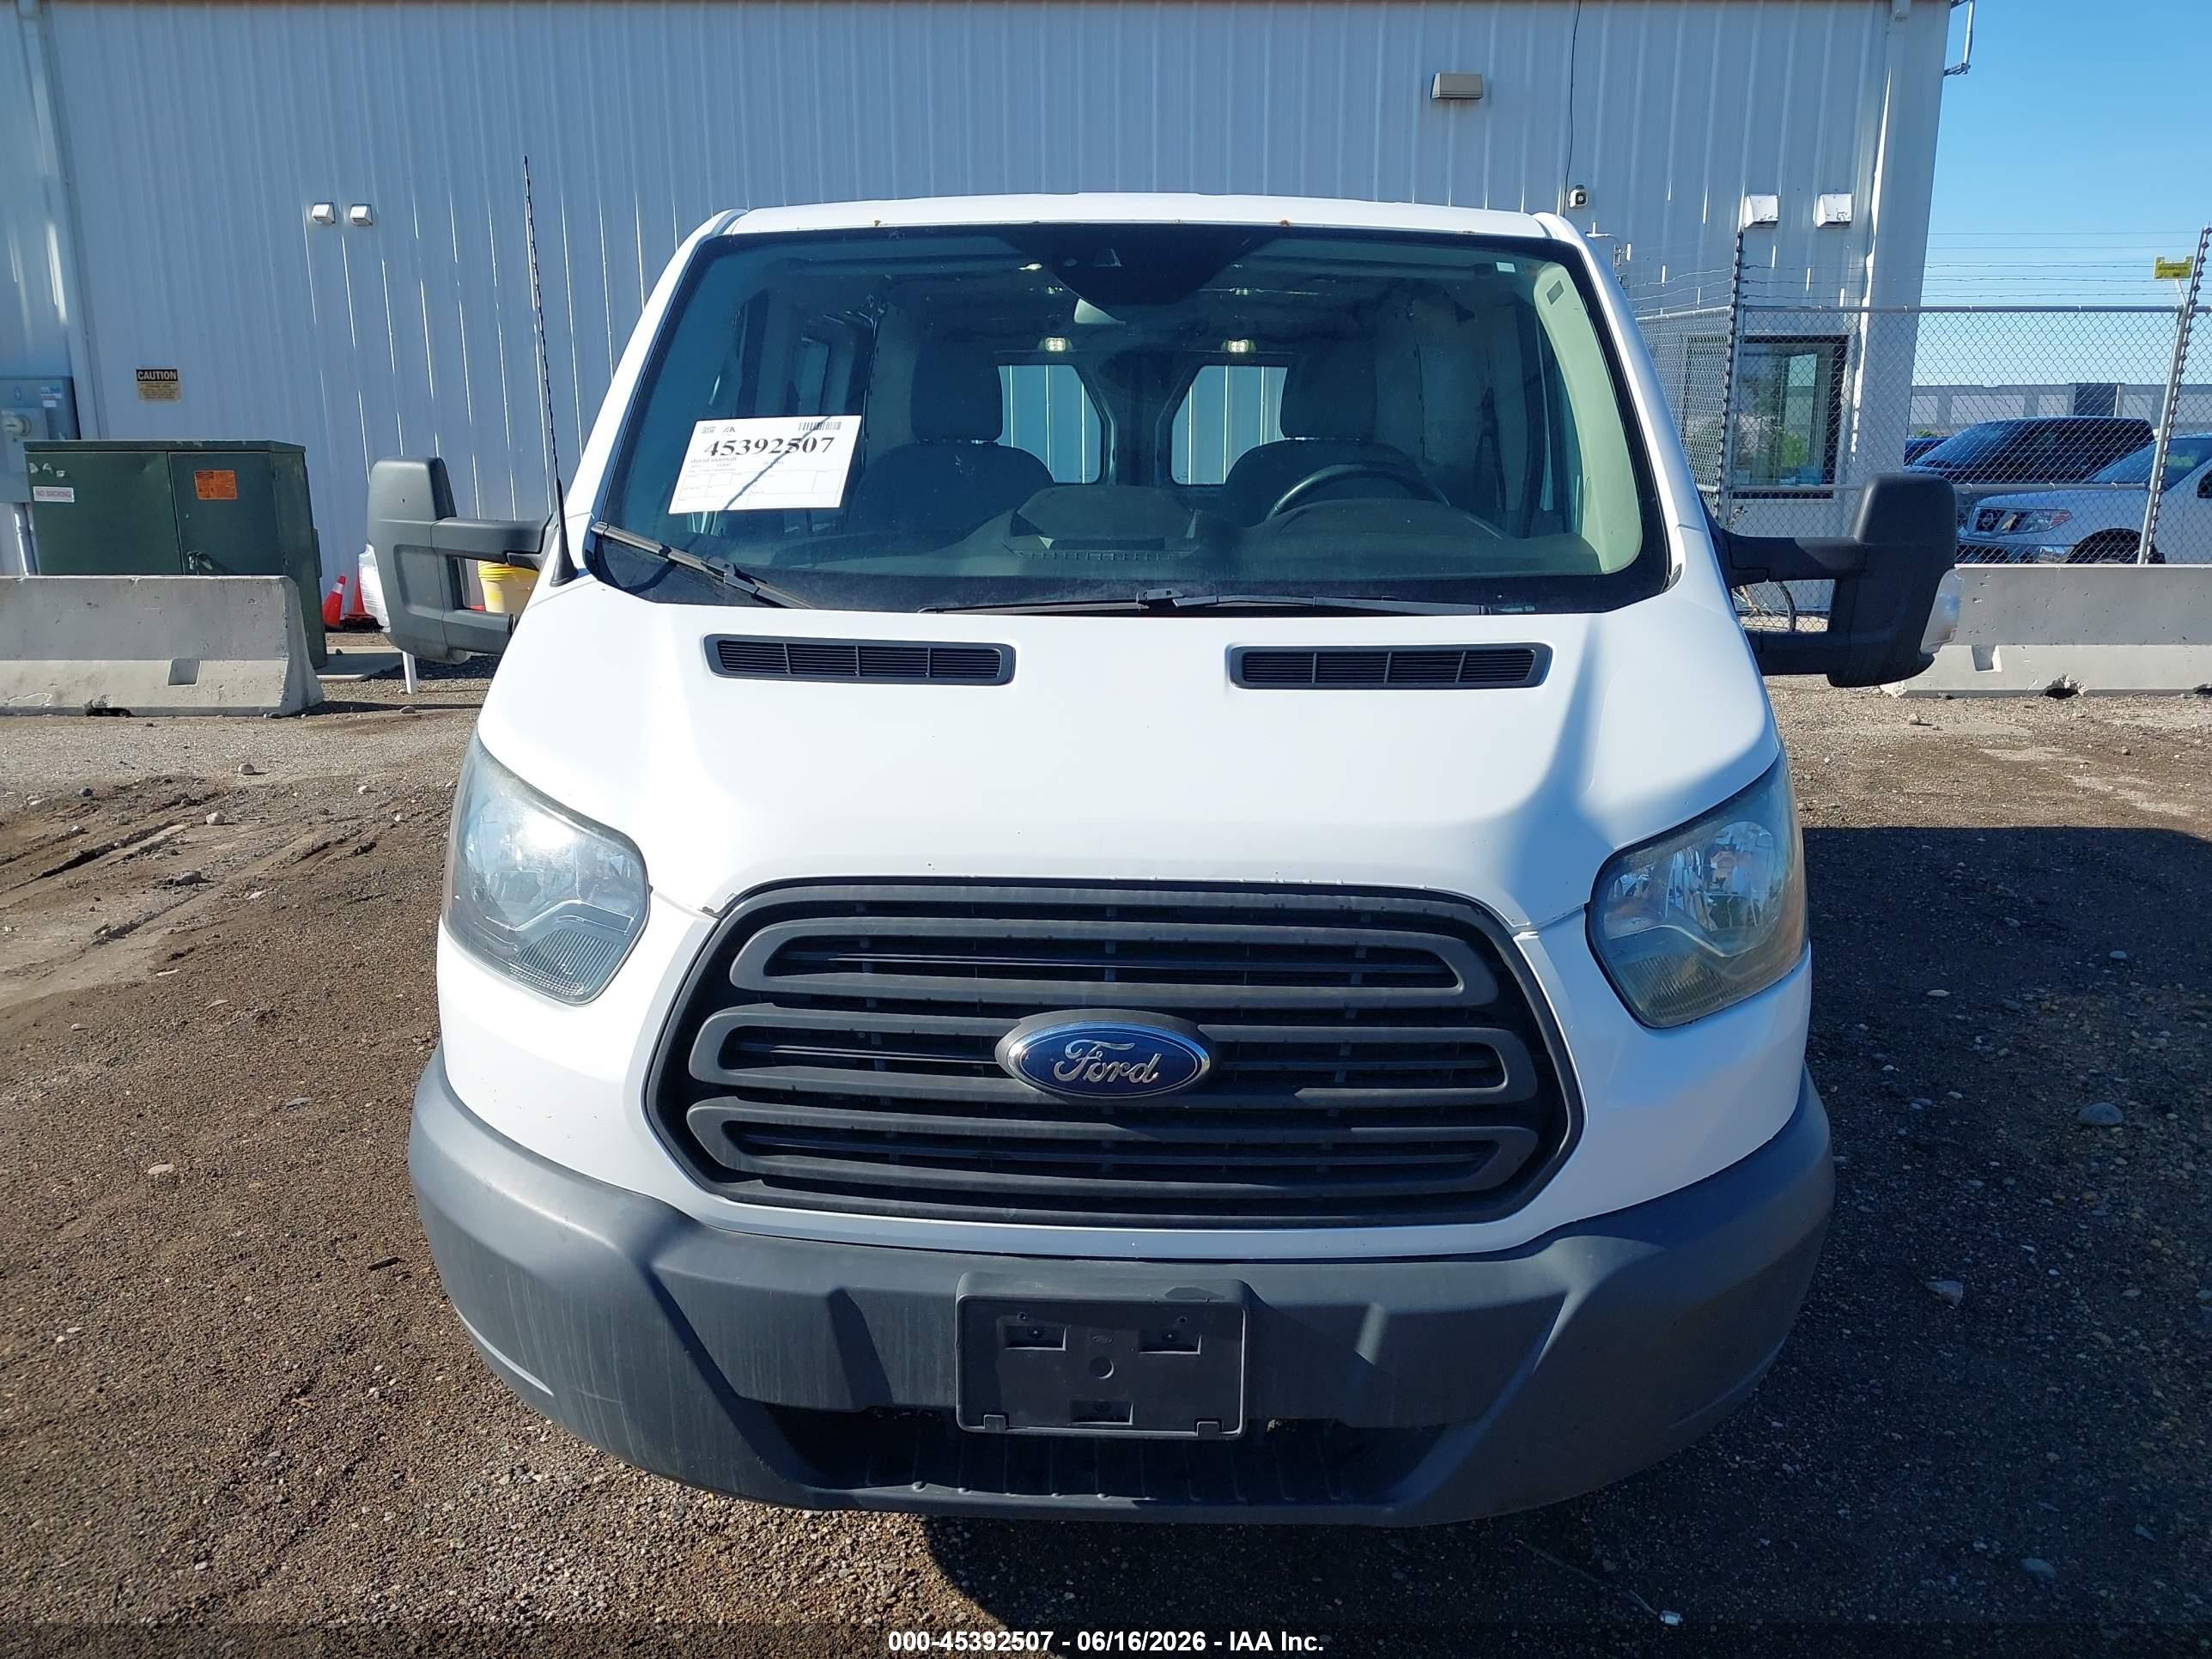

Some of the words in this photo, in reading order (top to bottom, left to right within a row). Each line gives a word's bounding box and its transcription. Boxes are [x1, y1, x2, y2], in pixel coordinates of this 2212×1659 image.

[137, 370, 177, 380] CAUTION
[705, 437, 834, 456] 45392507
[1054, 1039, 1162, 1084] Ford
